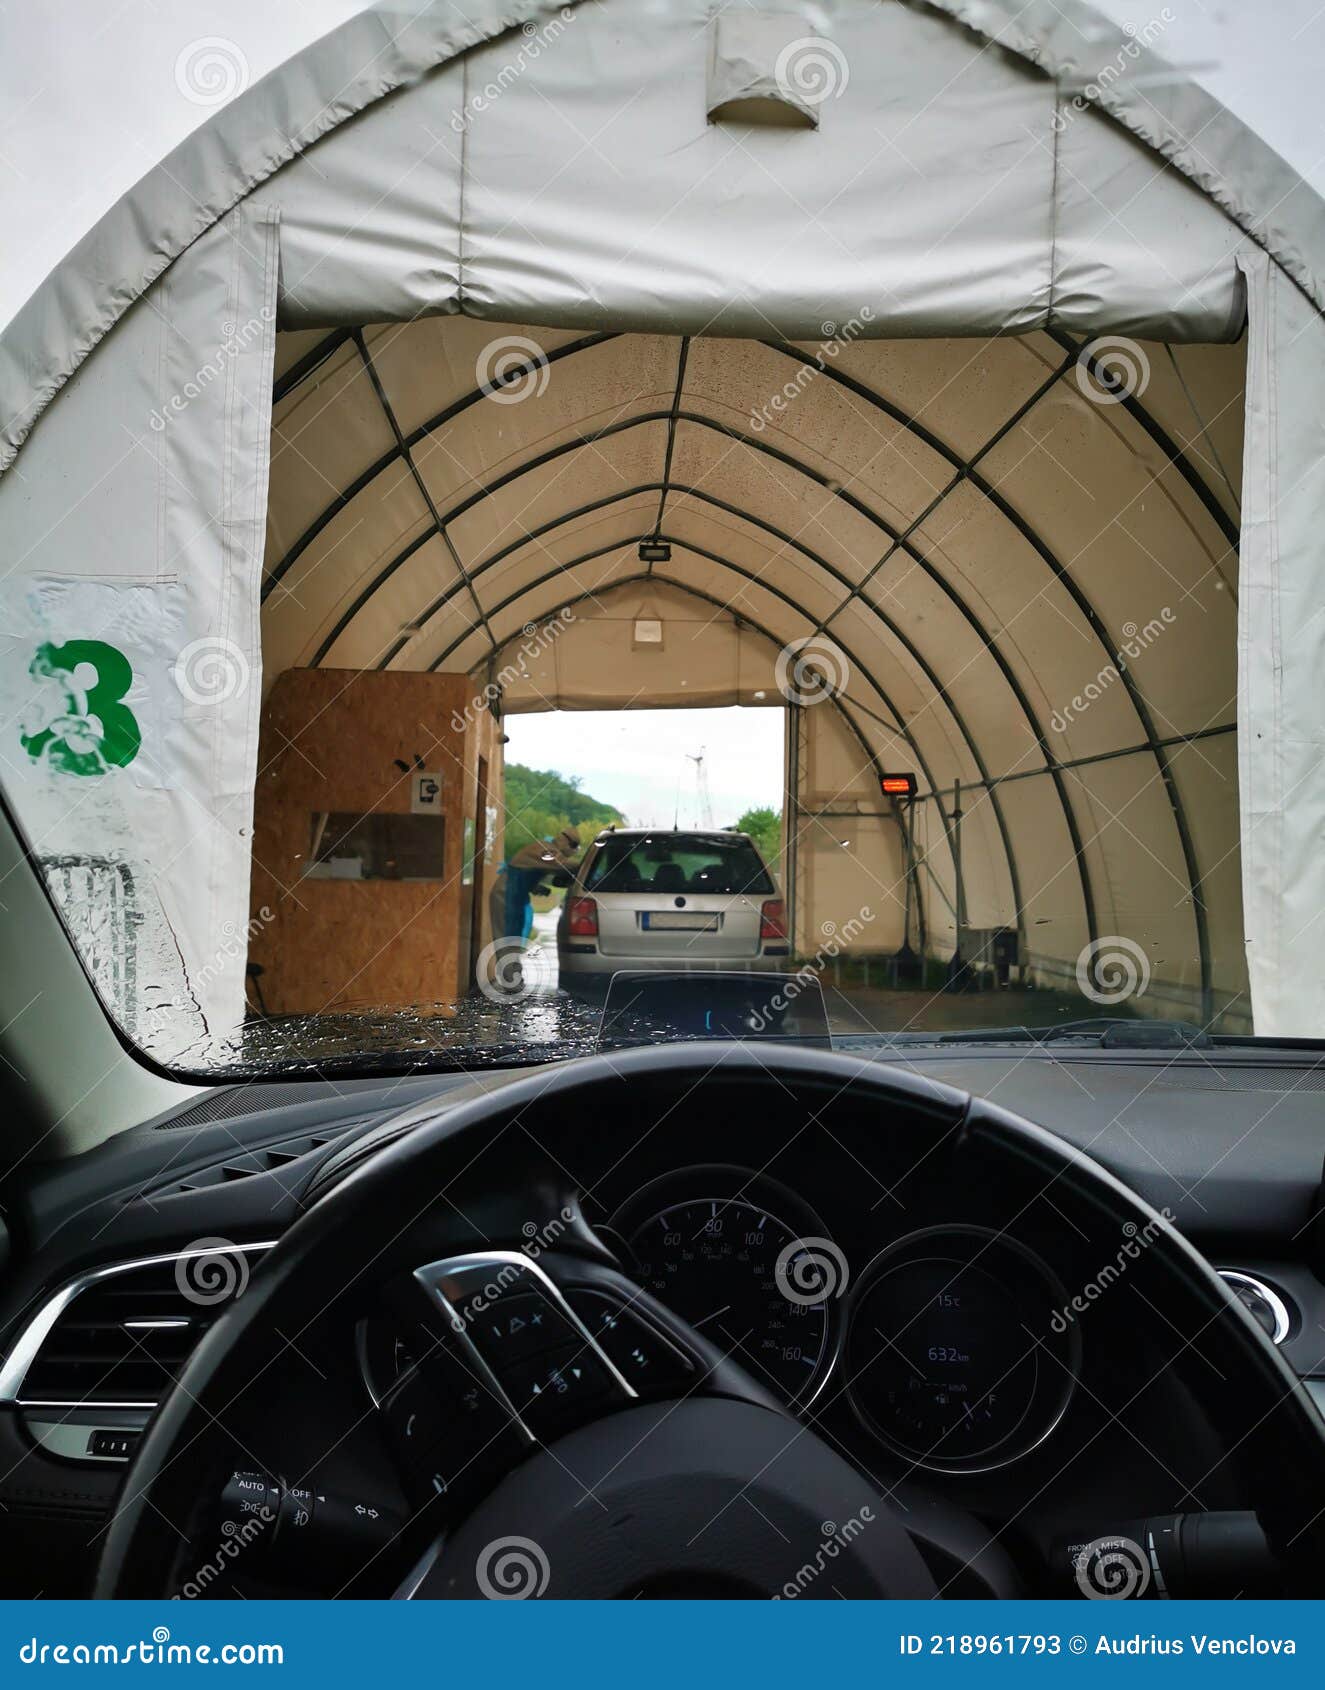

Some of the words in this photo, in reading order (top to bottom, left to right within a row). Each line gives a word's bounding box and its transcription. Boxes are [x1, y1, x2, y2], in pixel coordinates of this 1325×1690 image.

[705, 1219, 722, 1232] 80
[664, 1233, 681, 1246] 60
[744, 1233, 764, 1246] 100
[788, 1304, 807, 1316] 140
[782, 1347, 801, 1360] 160
[238, 1480, 264, 1492] AUTO
[291, 1488, 313, 1499] OFF
[1101, 1540, 1126, 1550] MIST
